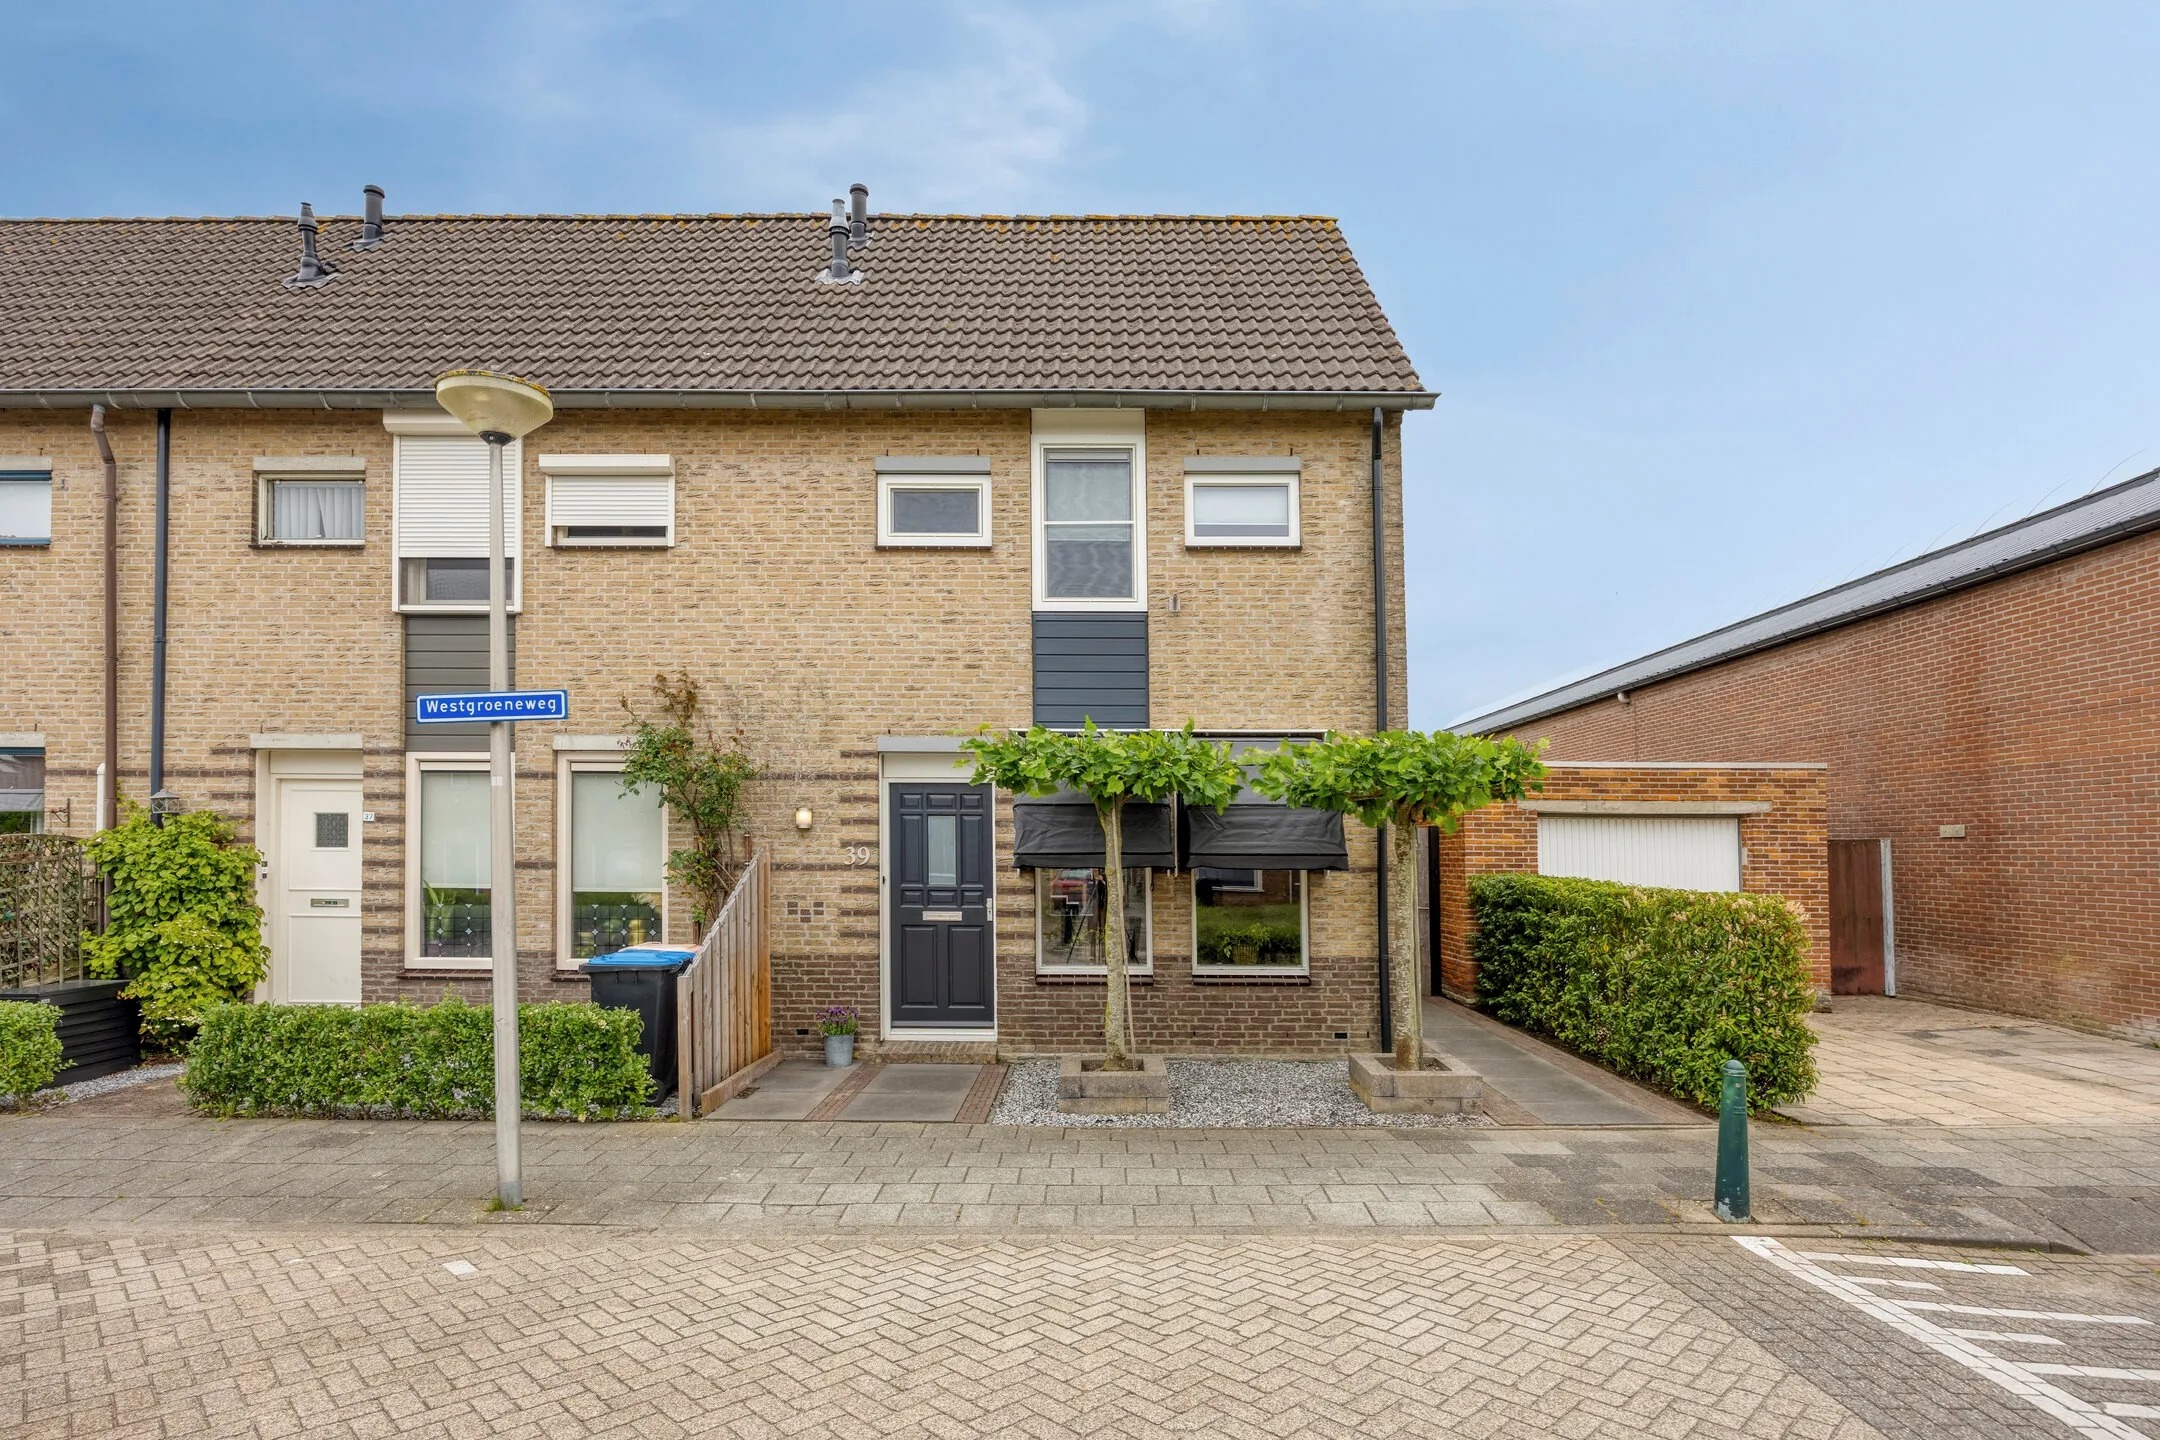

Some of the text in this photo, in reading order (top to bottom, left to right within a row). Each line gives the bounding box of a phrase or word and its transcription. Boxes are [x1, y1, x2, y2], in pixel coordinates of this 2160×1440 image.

[426, 699, 556, 715] Westgroeneweg
[364, 813, 374, 821] 37
[844, 846, 870, 865] 39
